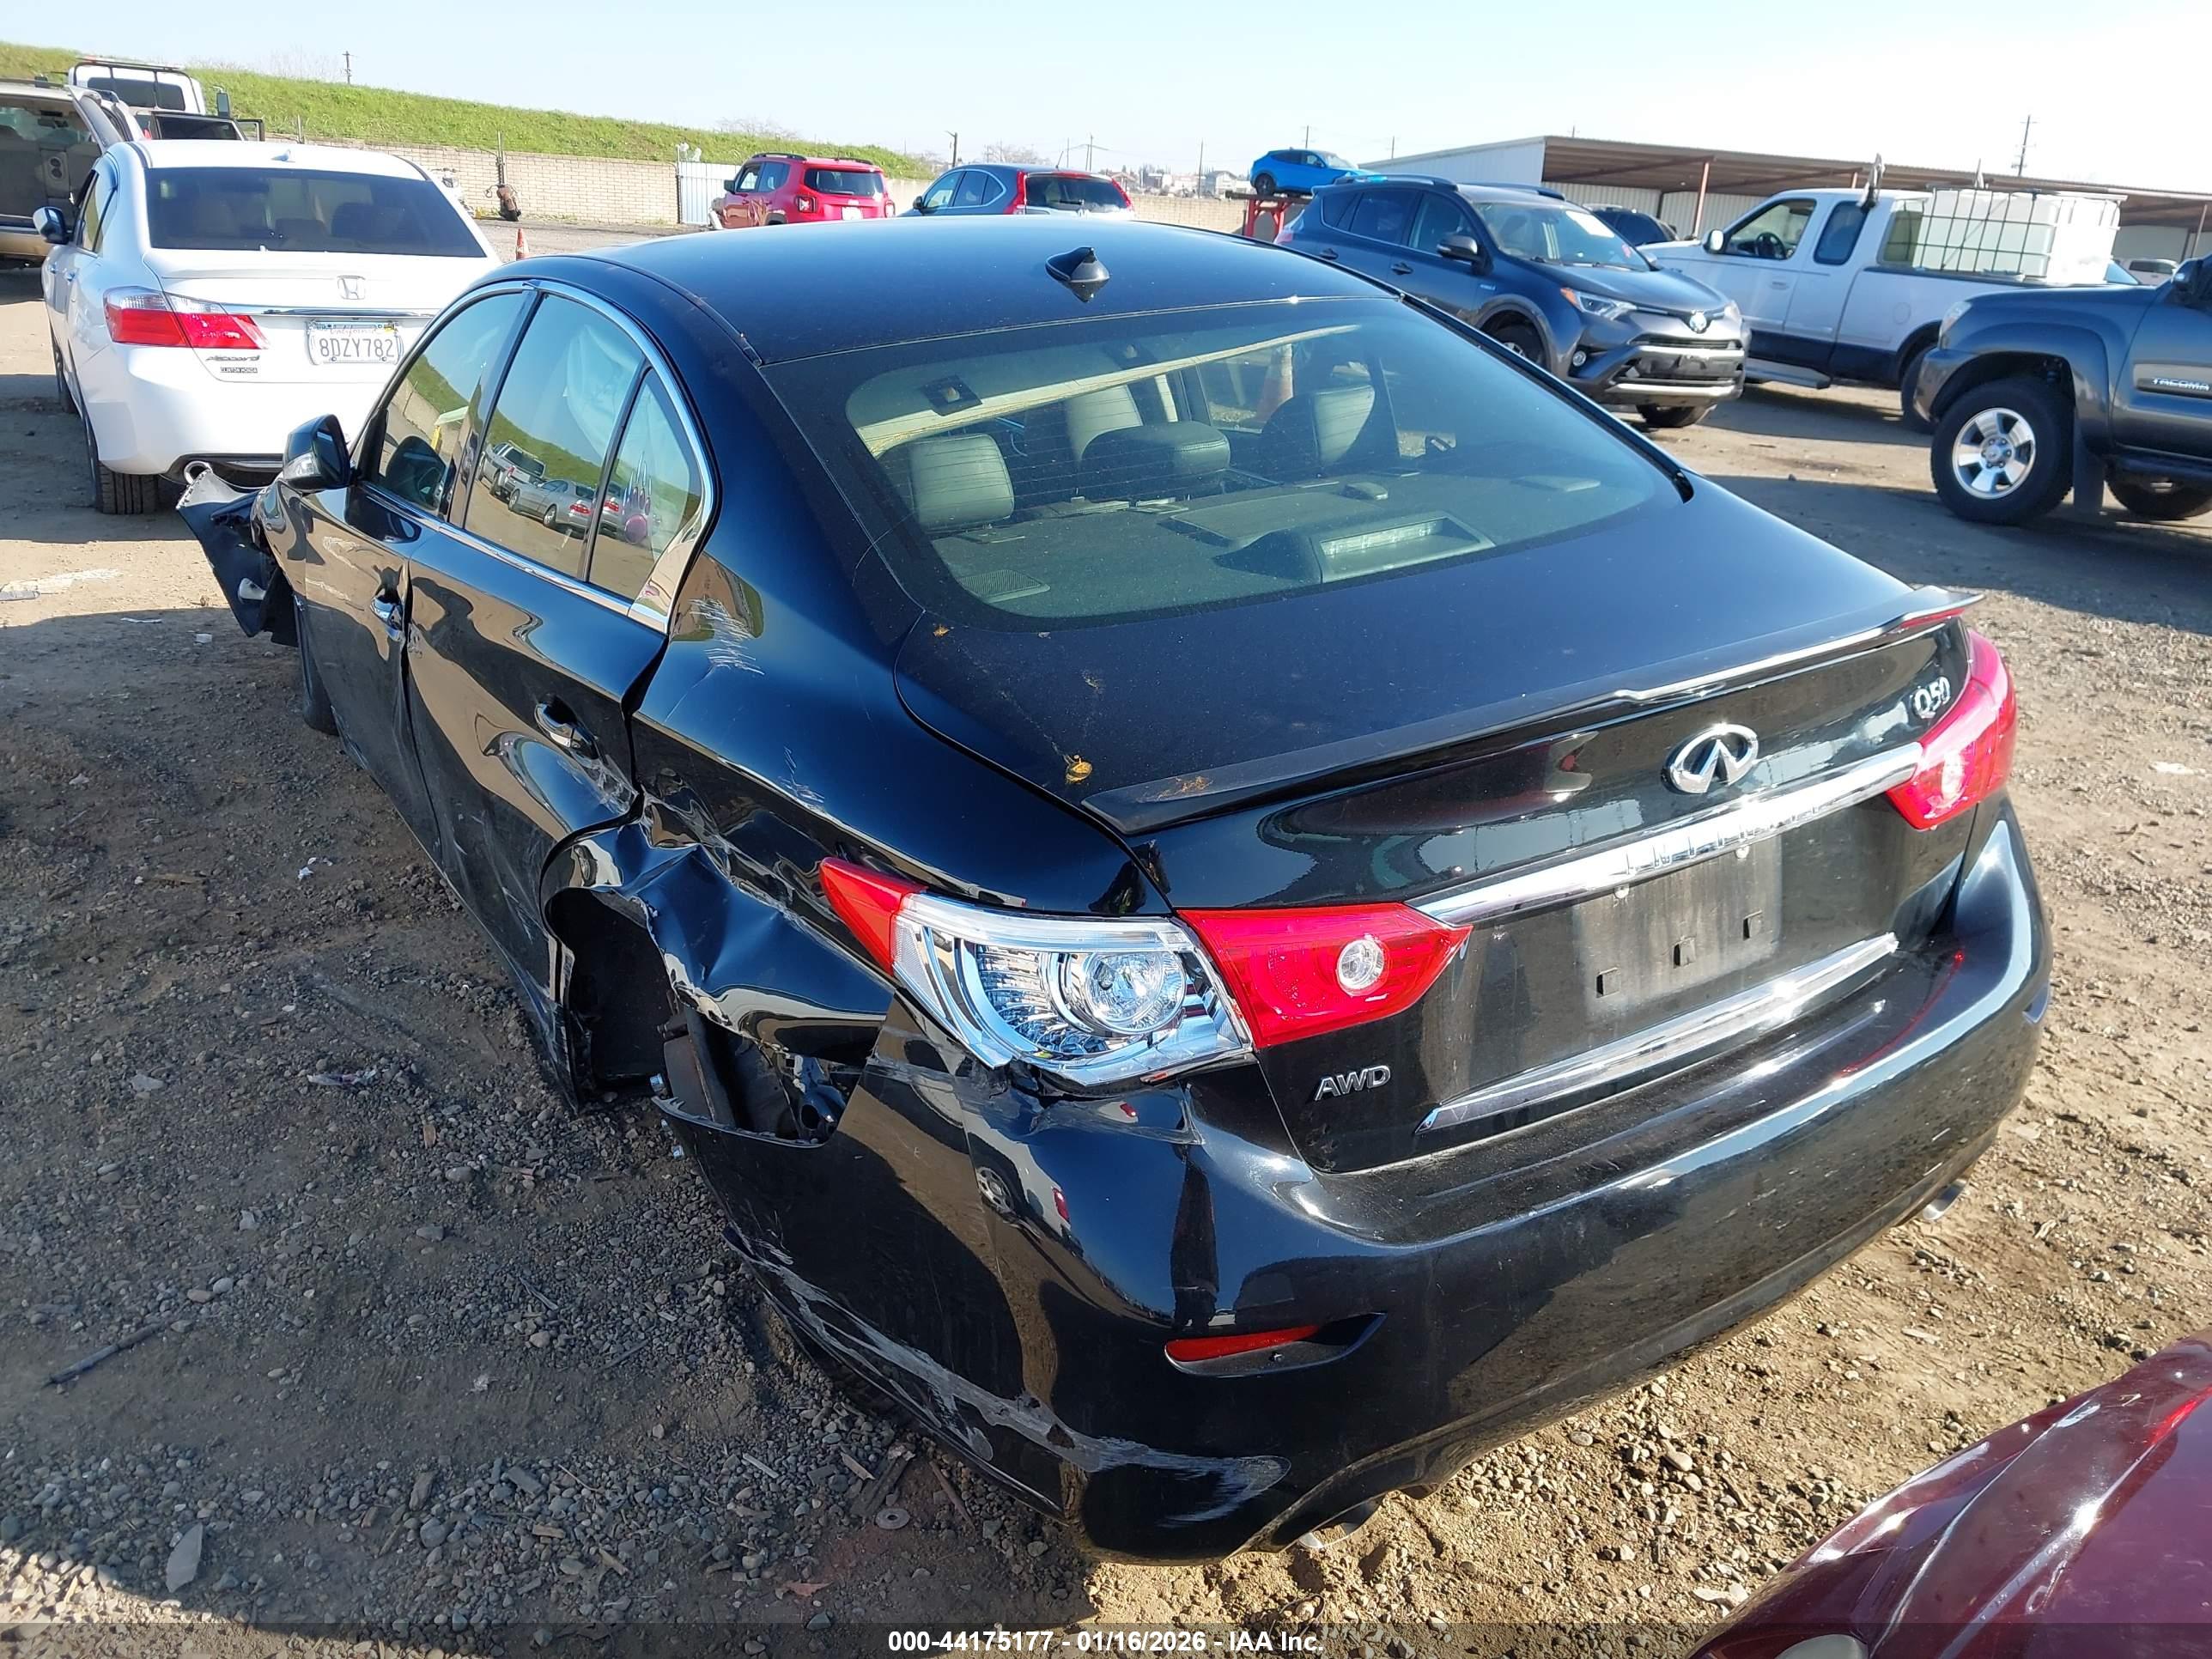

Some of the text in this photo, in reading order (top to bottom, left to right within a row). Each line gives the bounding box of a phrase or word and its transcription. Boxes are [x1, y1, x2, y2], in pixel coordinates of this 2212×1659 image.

[319, 337, 395, 357] 8DZY782
[2152, 377, 2209, 392] TACOMA
[1912, 676, 1952, 720] Q50
[1314, 1065, 1391, 1101] AWD
